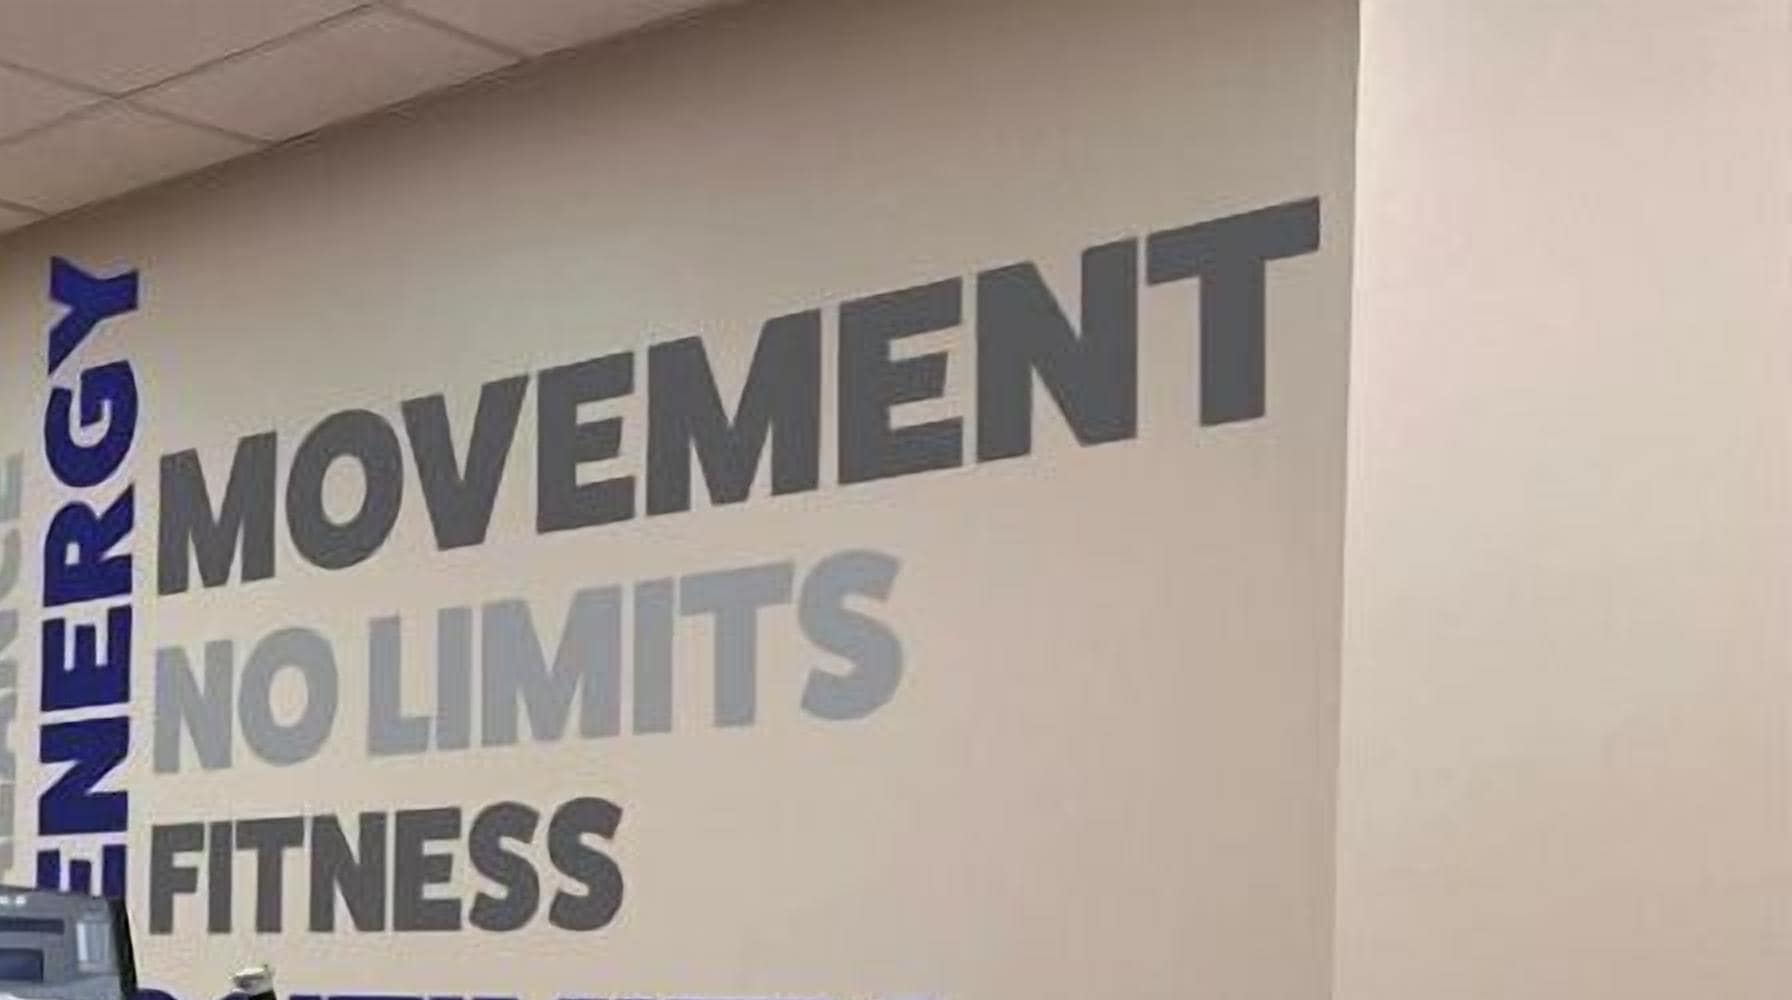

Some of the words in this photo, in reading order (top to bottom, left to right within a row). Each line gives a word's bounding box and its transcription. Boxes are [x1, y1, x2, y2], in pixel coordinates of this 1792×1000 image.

[157, 196, 1321, 597] MOVEMENT
[152, 625, 339, 775] NO
[365, 549, 904, 758] LIMITS
[147, 797, 625, 936] FITNESS
